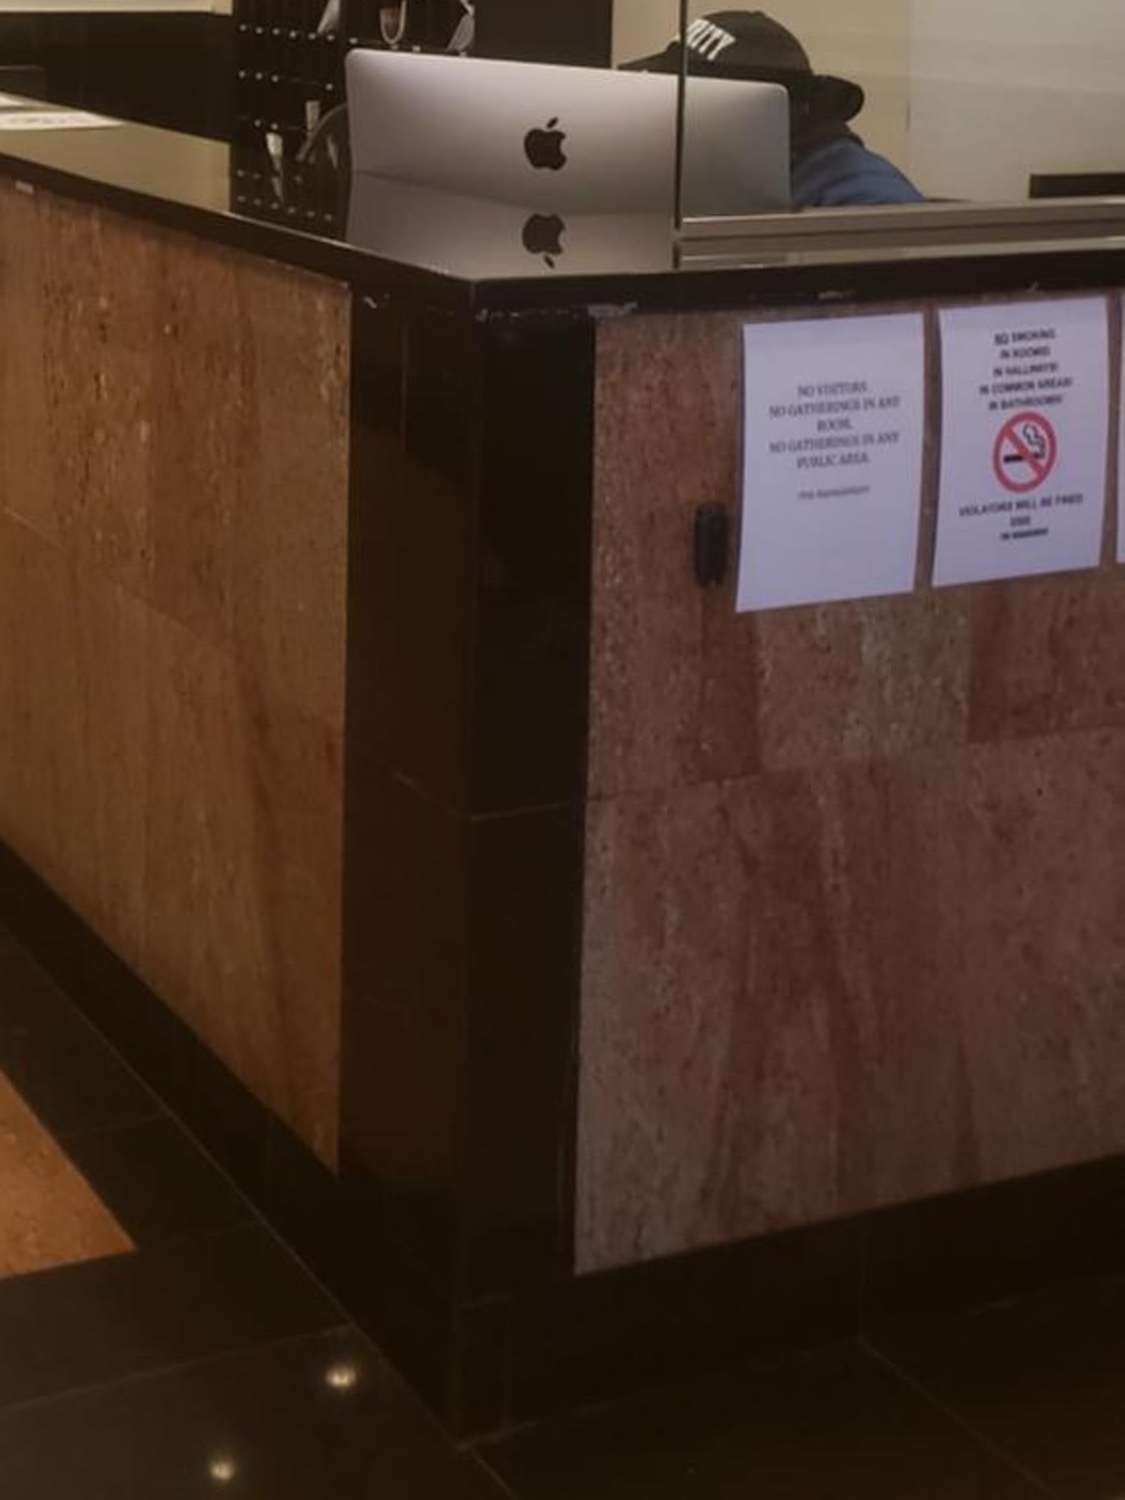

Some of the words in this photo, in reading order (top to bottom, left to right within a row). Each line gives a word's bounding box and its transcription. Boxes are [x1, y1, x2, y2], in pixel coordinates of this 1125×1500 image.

[797, 385, 815, 397] NO
[769, 405, 786, 417] NO
[863, 398, 875, 410] IN
[769, 441, 786, 453] NO
[862, 433, 875, 446] IN
